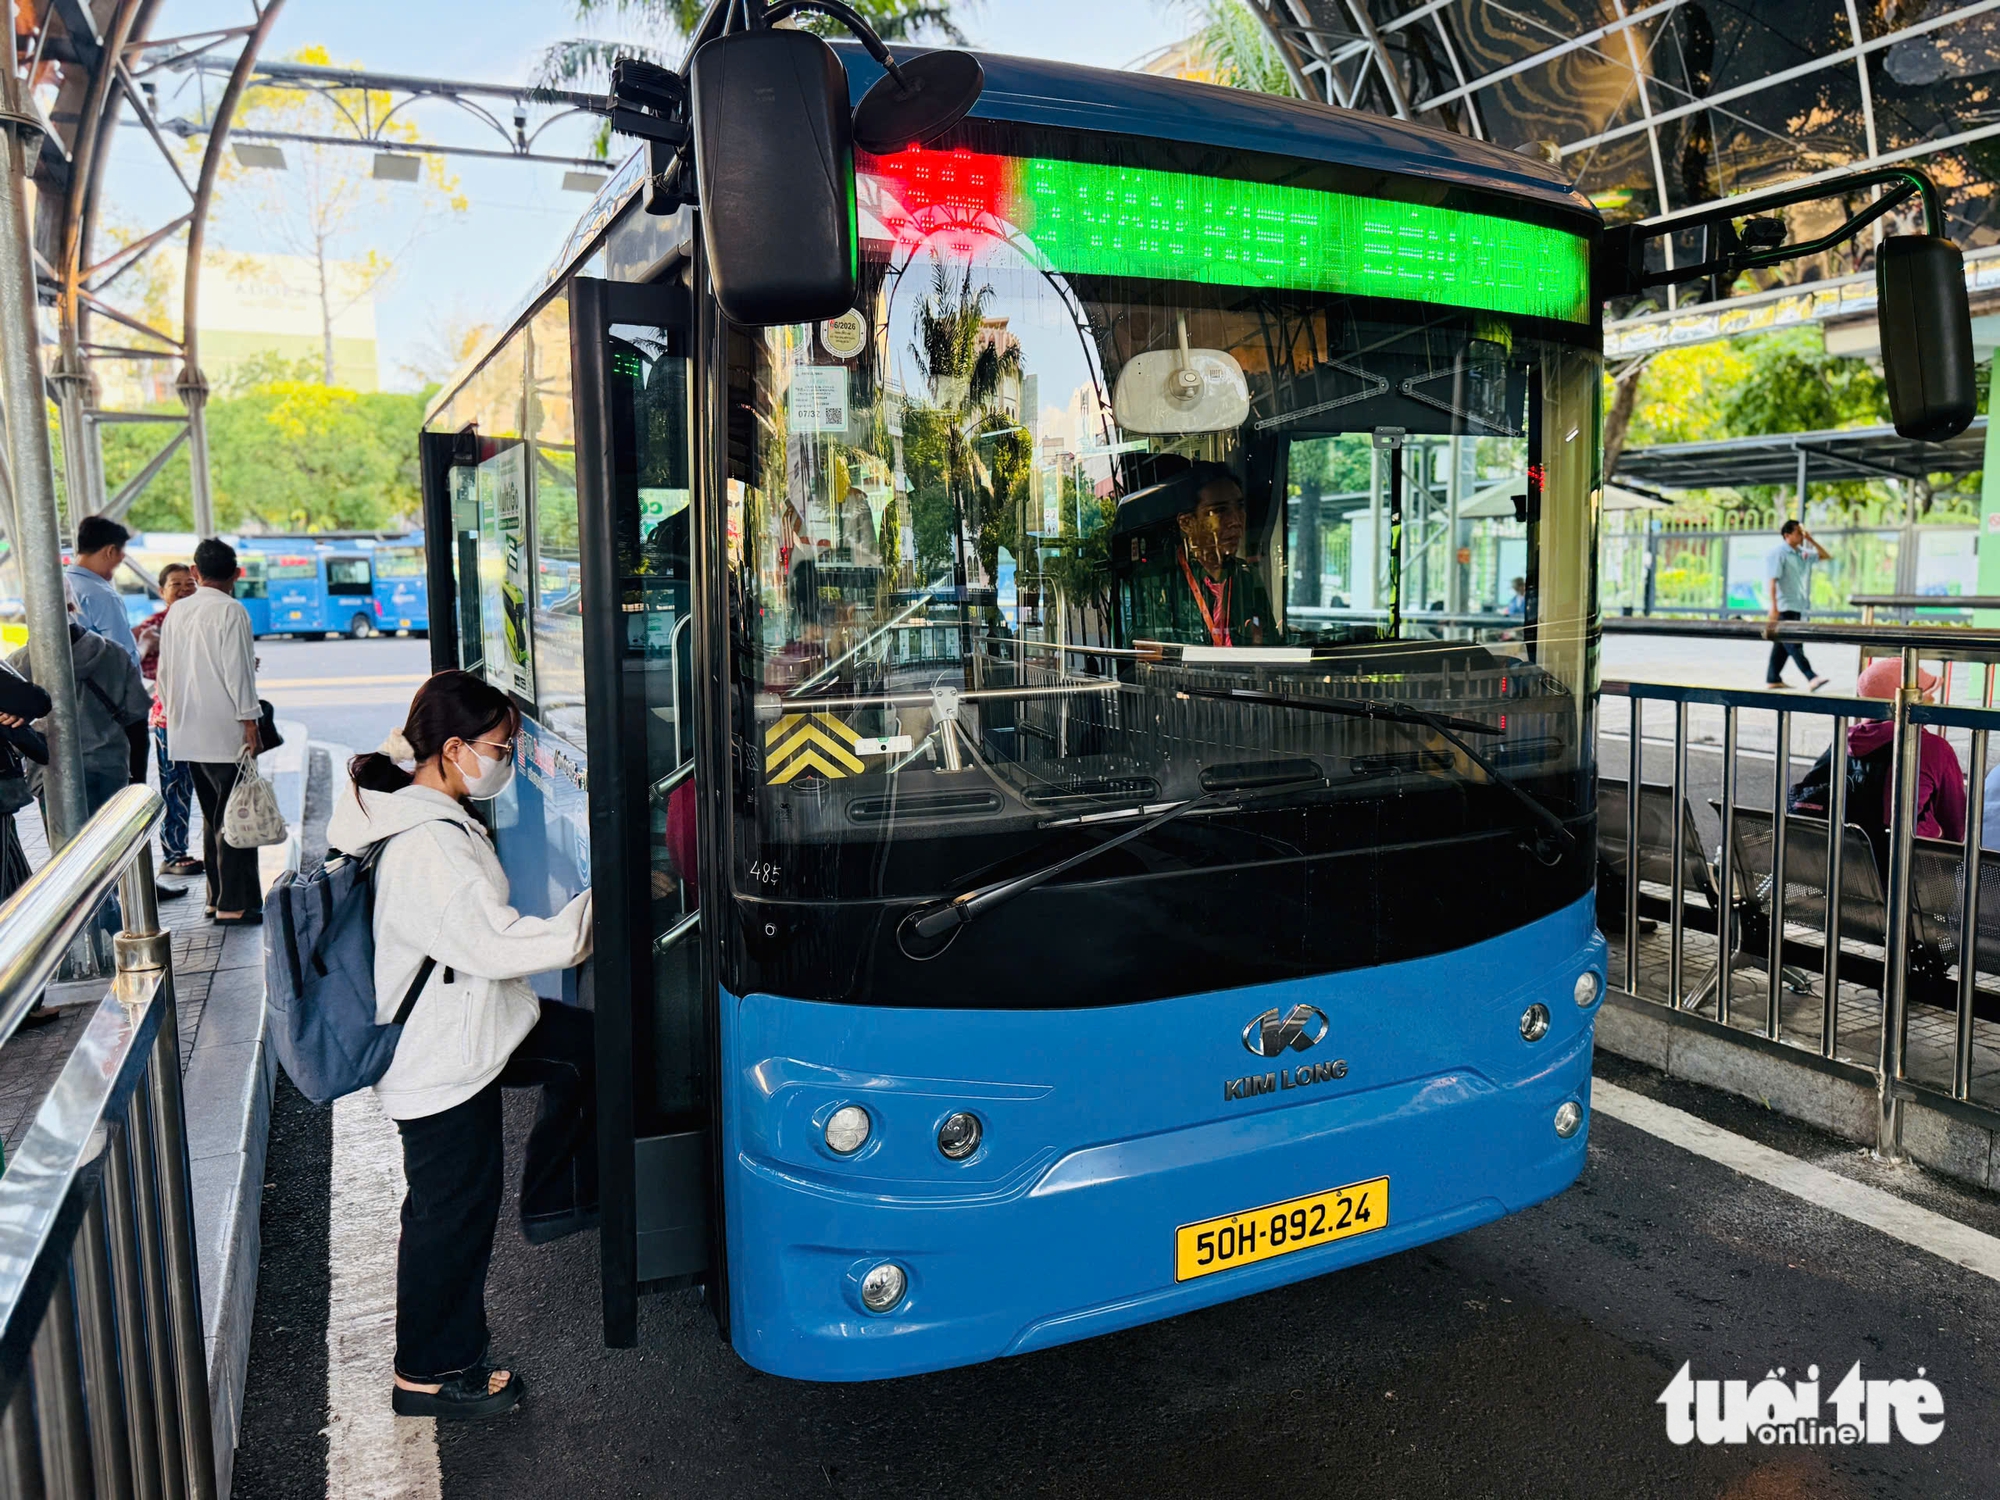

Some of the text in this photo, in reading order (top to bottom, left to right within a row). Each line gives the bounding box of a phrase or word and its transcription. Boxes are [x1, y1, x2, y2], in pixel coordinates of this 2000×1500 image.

[1224, 1058, 1349, 1101] KIM LONG
[1197, 1192, 1371, 1265] 50H-892.24
